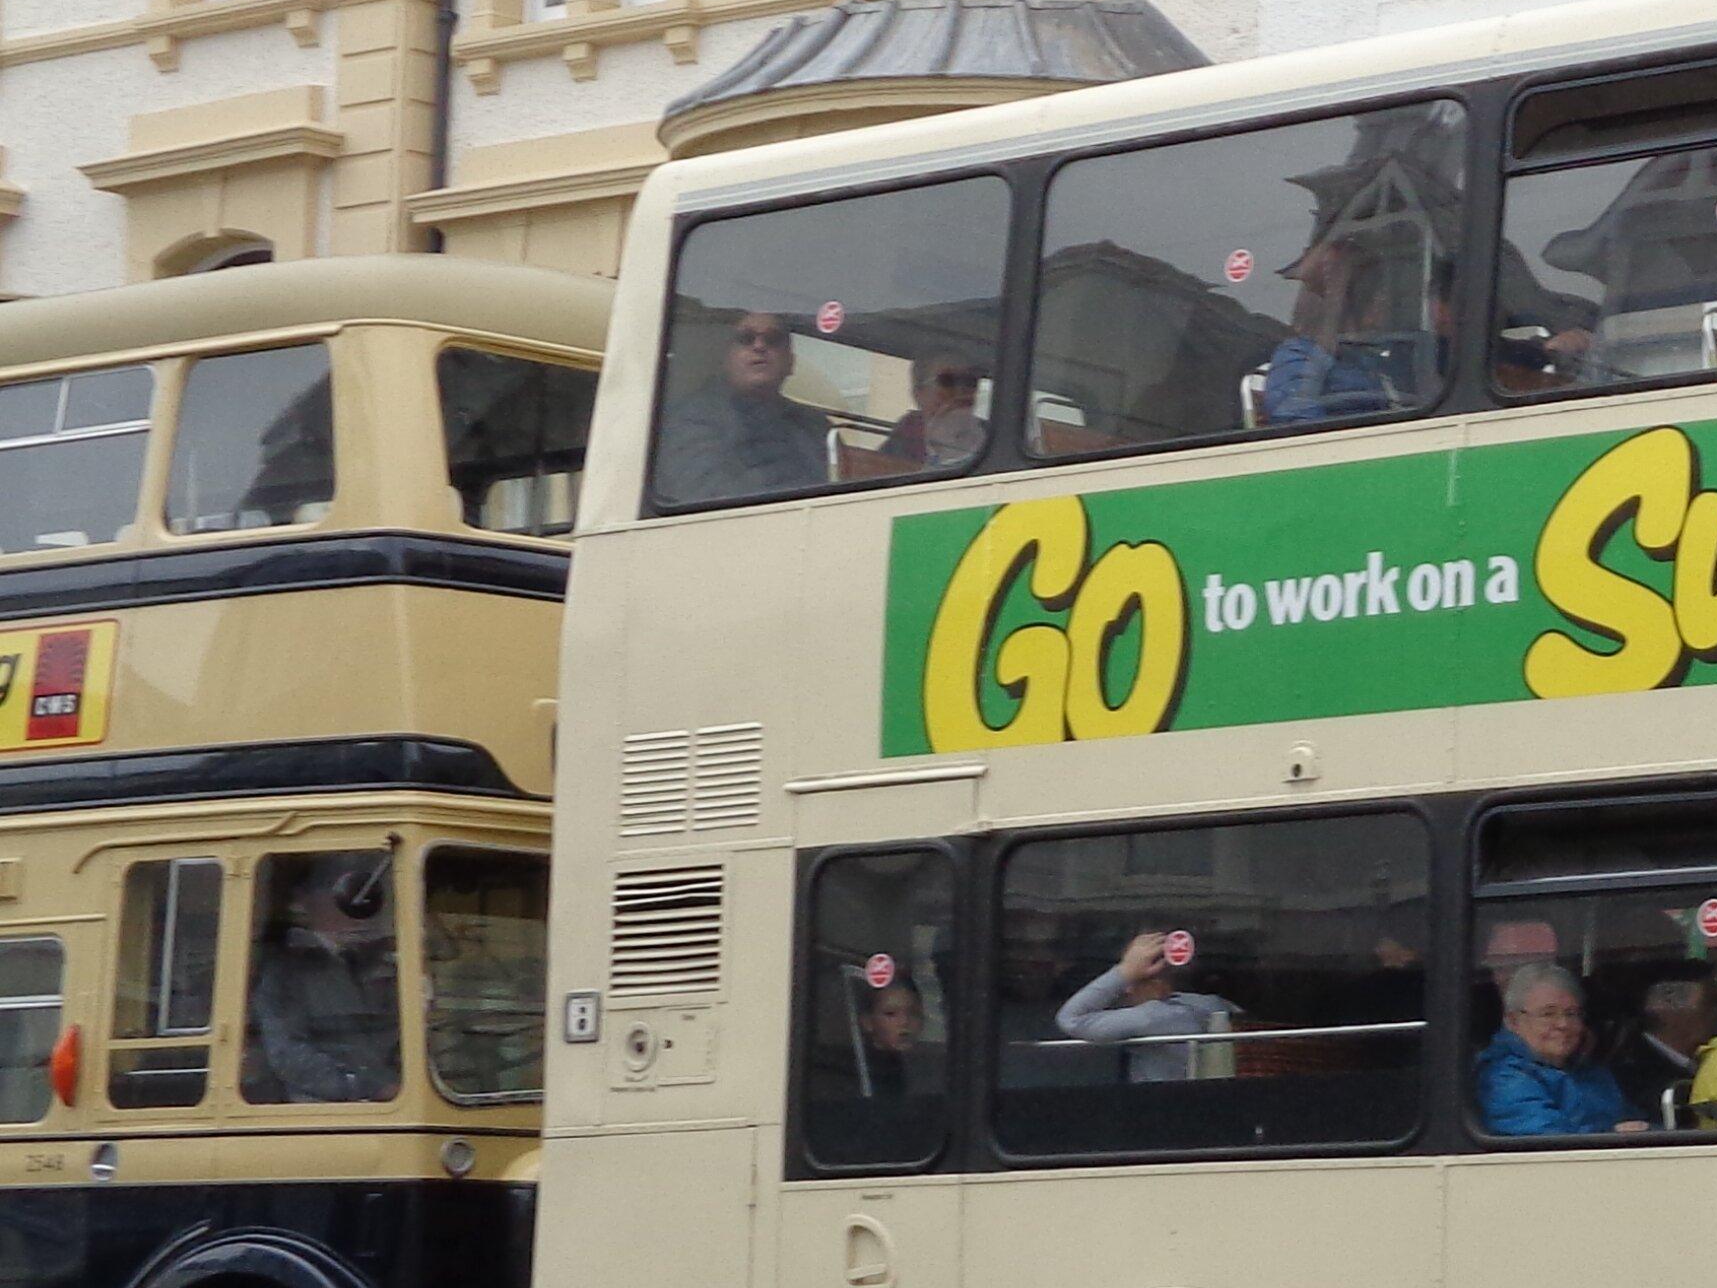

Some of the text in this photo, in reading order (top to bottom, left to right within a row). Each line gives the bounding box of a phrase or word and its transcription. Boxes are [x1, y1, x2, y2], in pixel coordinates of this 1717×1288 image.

[1203, 573, 1256, 632] to
[1265, 551, 1401, 626] work
[1407, 558, 1475, 611] on
[1485, 555, 1519, 604] a
